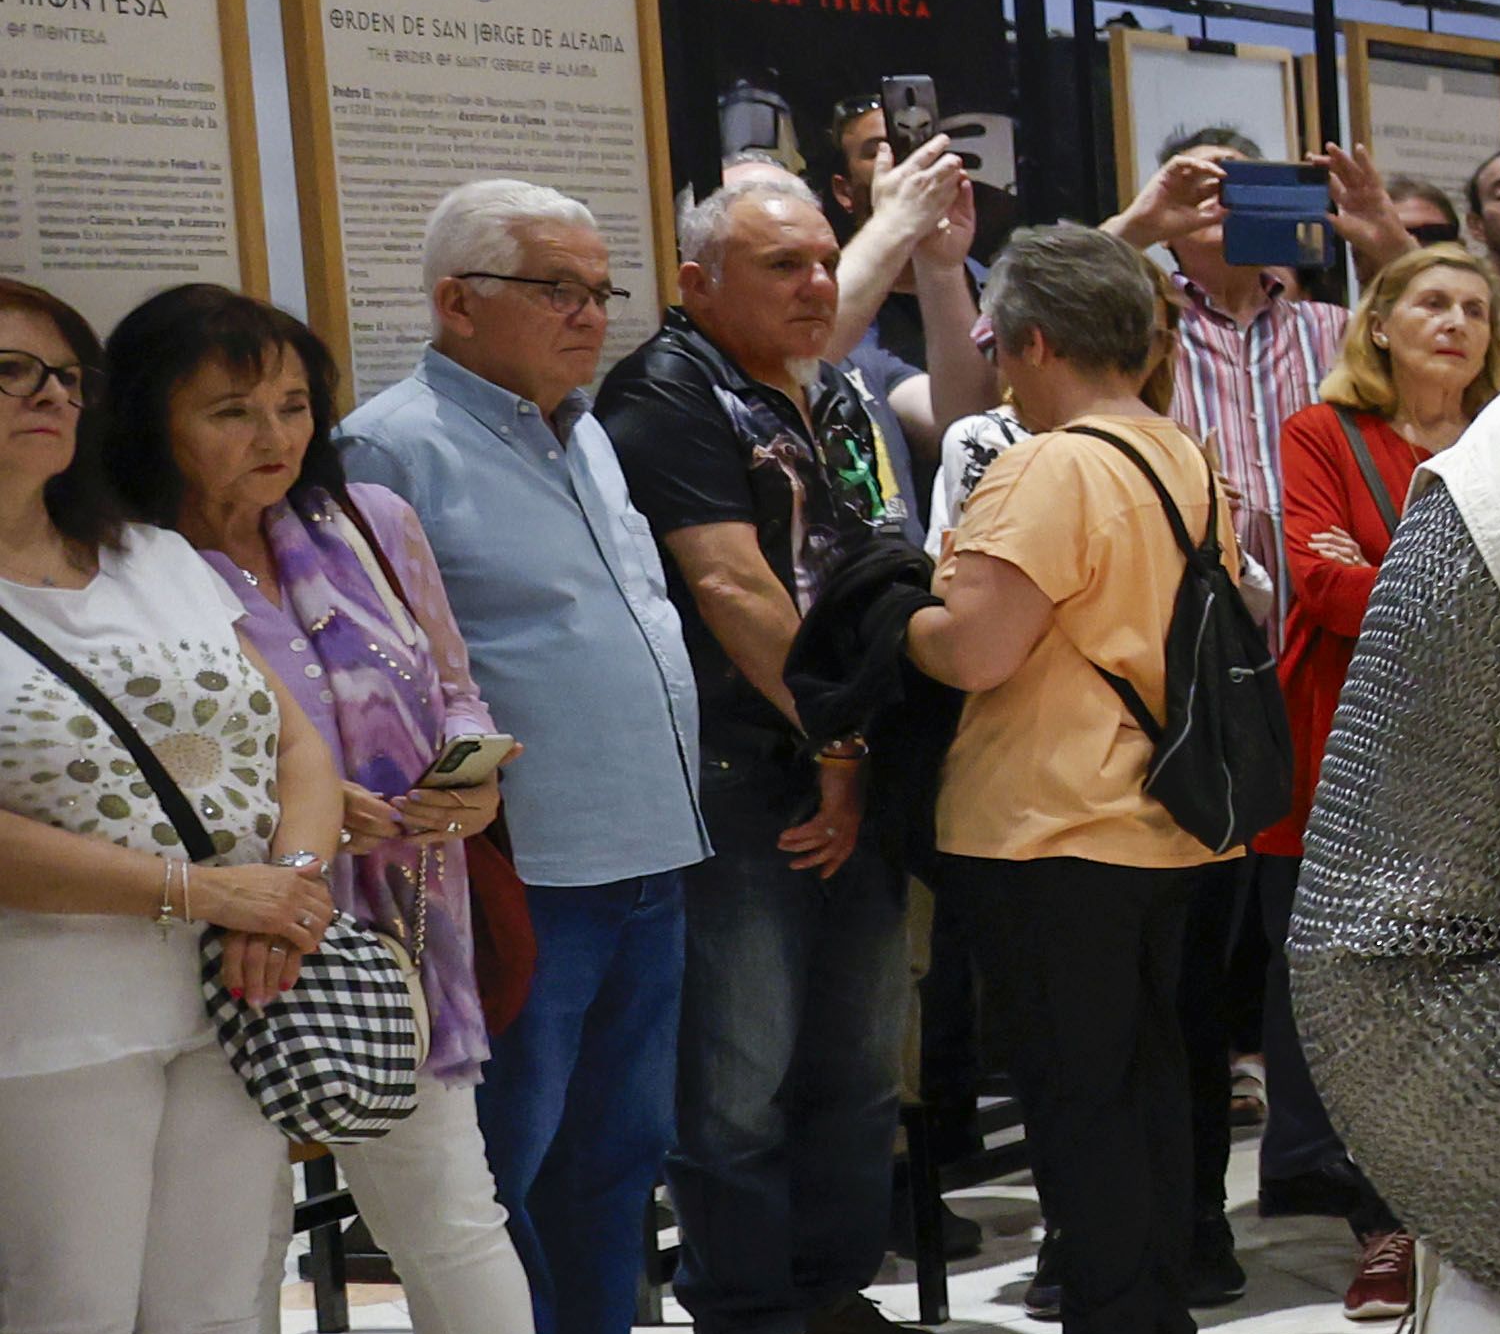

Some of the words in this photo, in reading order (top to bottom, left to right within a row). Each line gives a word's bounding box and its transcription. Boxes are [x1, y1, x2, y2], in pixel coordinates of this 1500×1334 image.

[329, 9, 395, 34] ORDEN
[403, 15, 425, 37] DE
[433, 19, 466, 41] SAN
[474, 24, 526, 46] JORGE
[532, 28, 553, 49] DE
[559, 32, 625, 54] ALFAMA
